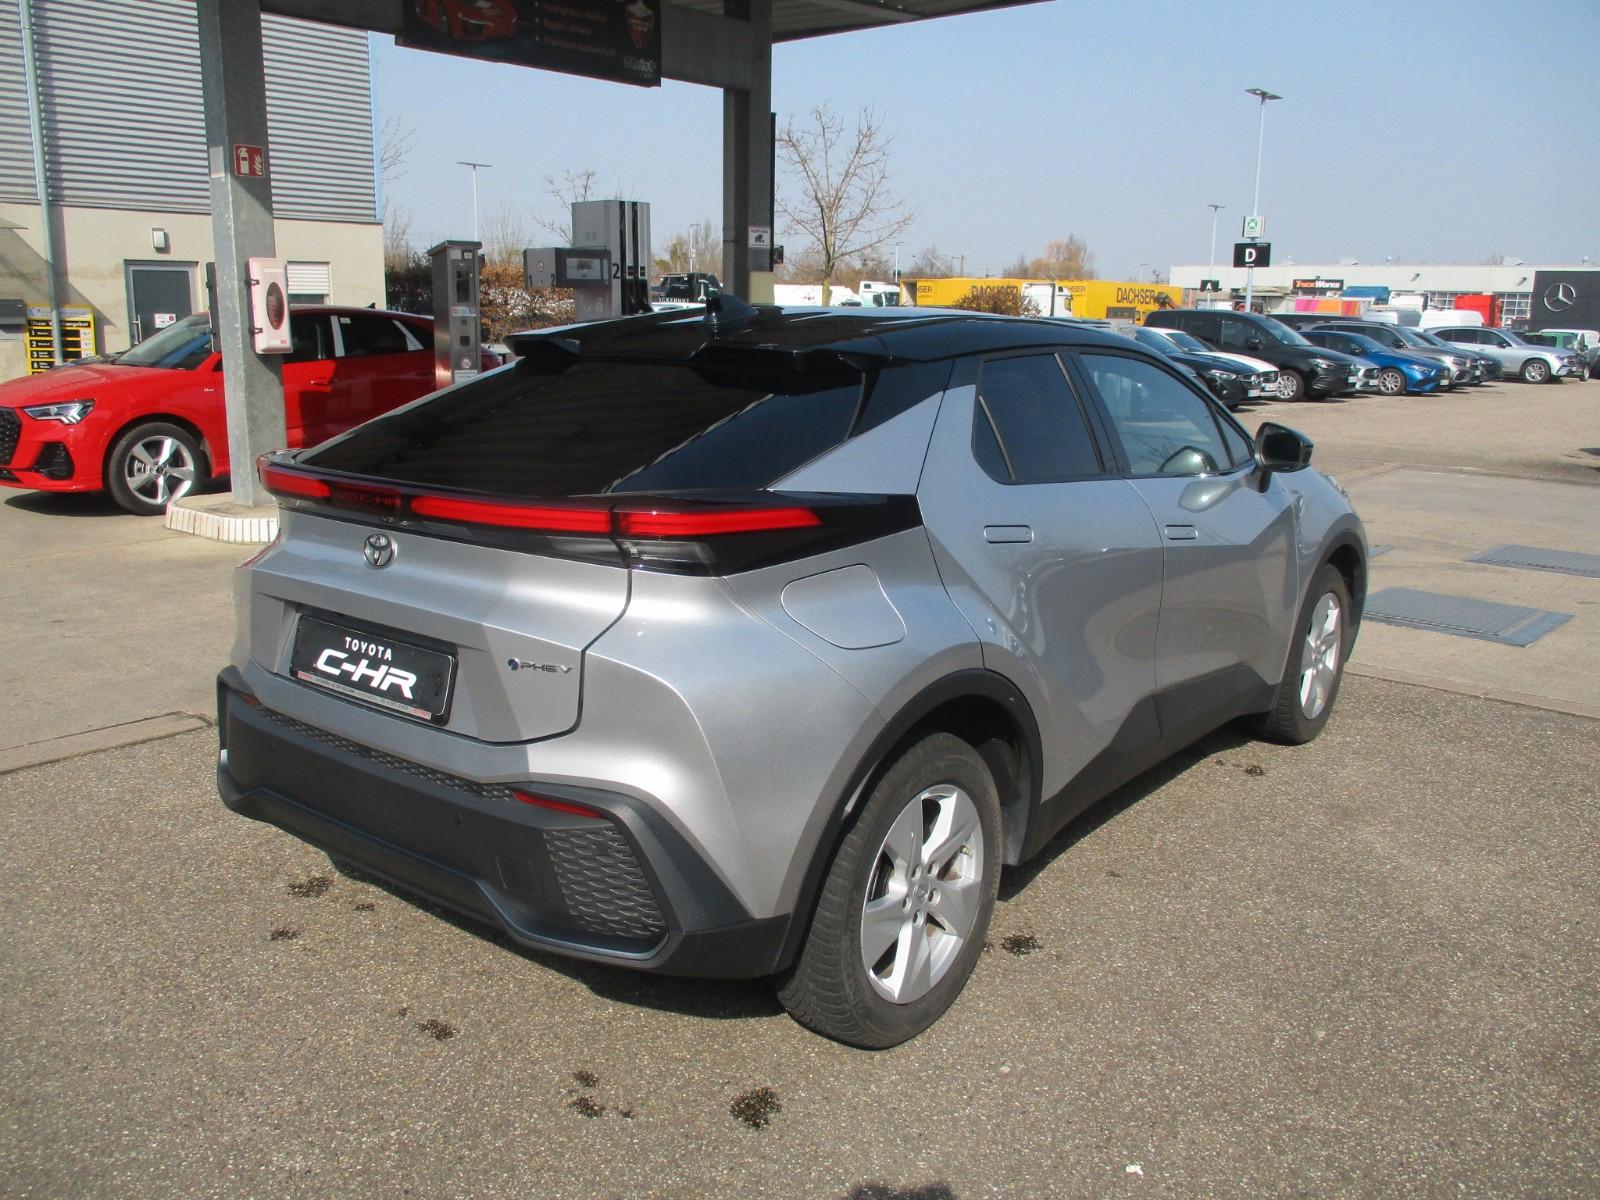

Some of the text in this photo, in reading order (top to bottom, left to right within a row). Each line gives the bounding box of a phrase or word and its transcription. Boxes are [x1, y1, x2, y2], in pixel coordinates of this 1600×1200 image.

[1245, 248, 1256, 262] D
[612, 263, 621, 280] 2
[1116, 287, 1156, 305] DACHSER
[344, 636, 392, 661] TOYOTA
[316, 648, 417, 699] C-HR
[520, 661, 575, 674] PHEV
